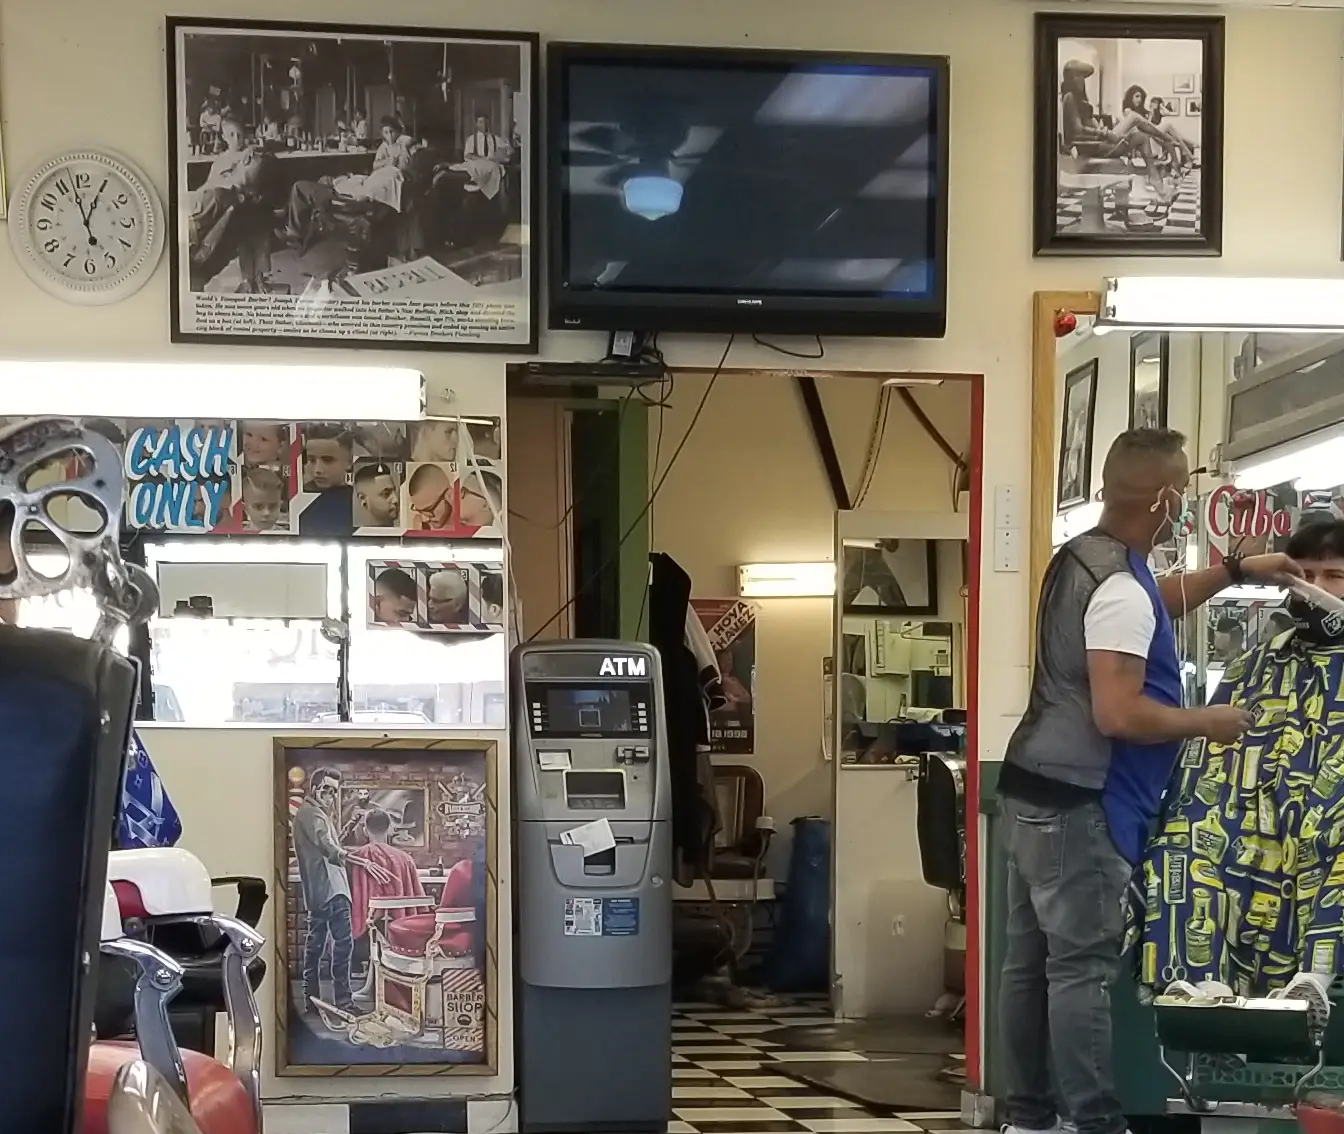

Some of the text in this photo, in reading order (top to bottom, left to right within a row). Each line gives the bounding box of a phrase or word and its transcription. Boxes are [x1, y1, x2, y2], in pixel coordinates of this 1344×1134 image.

[55, 179, 70, 196] 11
[75, 172, 91, 189] 12
[40, 193, 58, 212] 10
[111, 193, 129, 210] 2
[36, 218, 53, 231] 9
[119, 217, 136, 229] 3
[44, 239, 60, 253] 8
[63, 252, 76, 268] 7
[84, 258, 97, 275] 6
[103, 251, 116, 269] 5
[125, 424, 233, 481] CASH
[129, 480, 228, 533] ONLY
[1205, 485, 1293, 538] Cuba
[713, 601, 748, 637] HOYA
[599, 657, 646, 676] ATM
[447, 992, 484, 1002] BARBER
[446, 1002, 483, 1014] SHOP
[452, 1034, 476, 1043] OPEN
